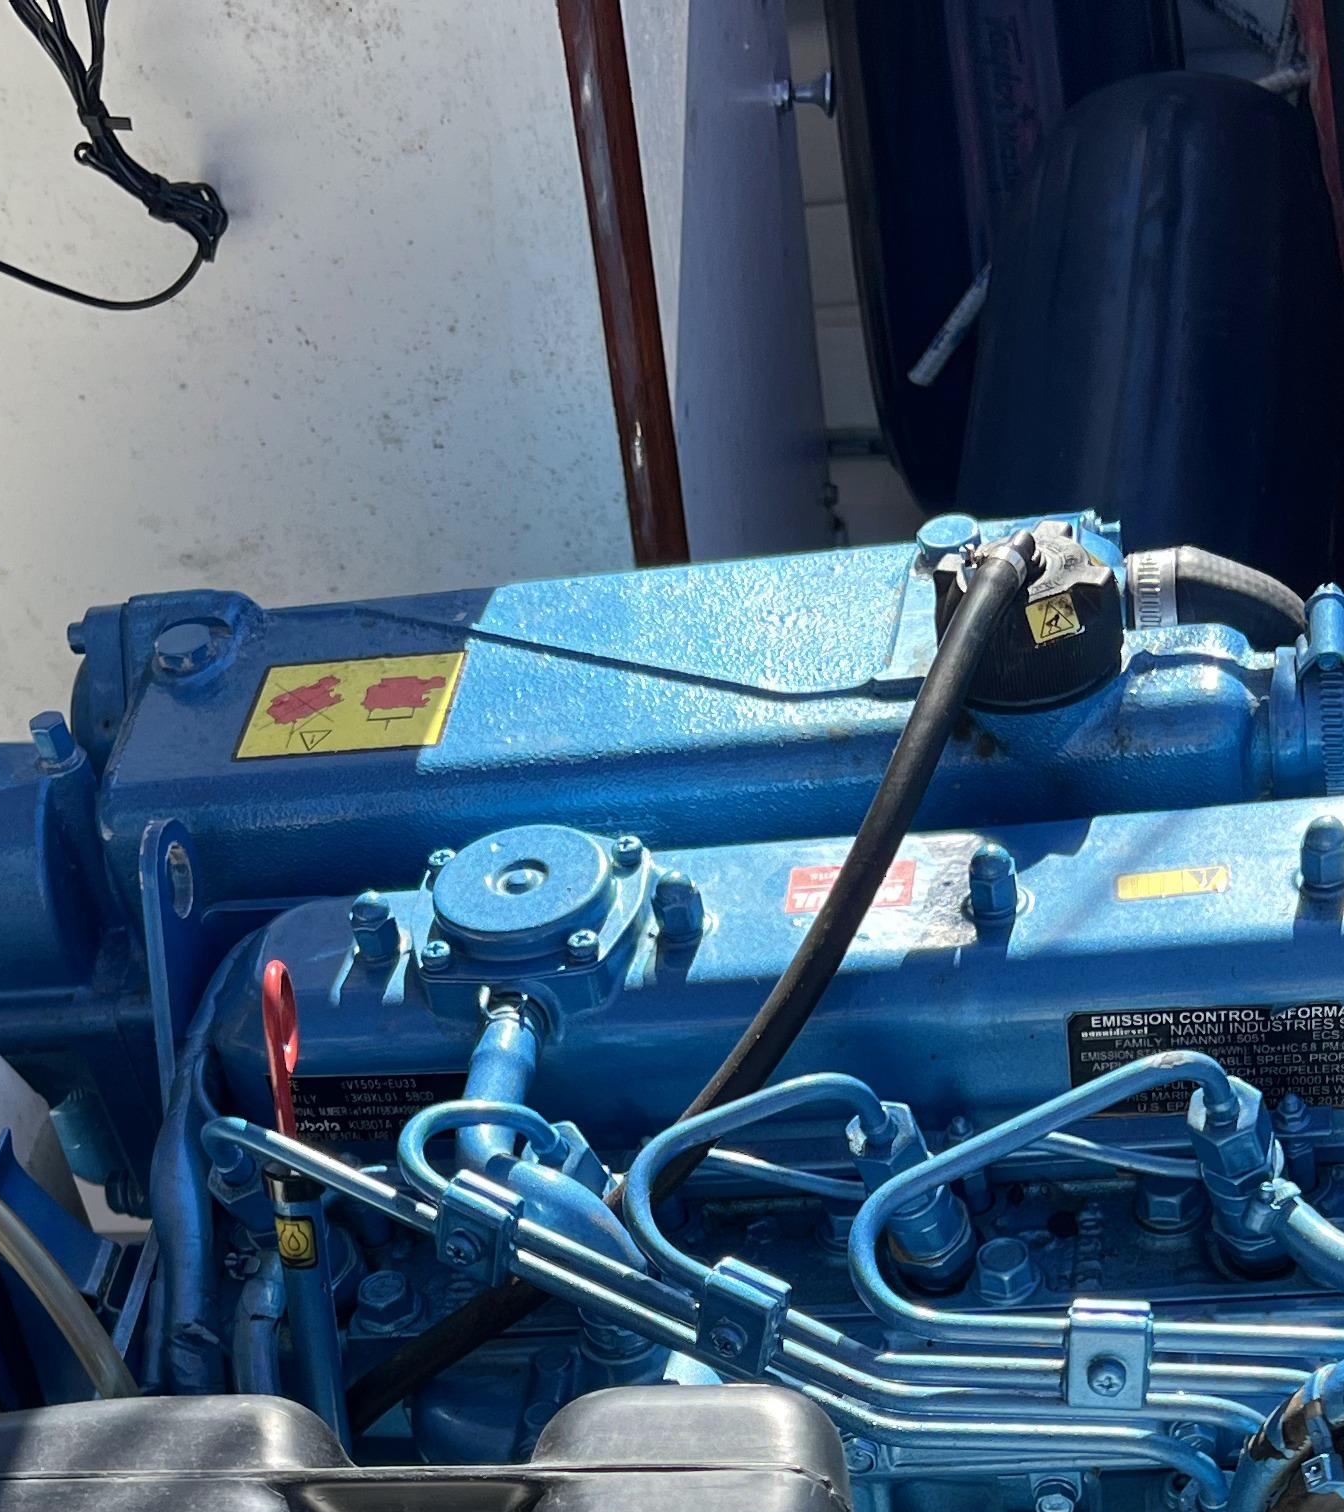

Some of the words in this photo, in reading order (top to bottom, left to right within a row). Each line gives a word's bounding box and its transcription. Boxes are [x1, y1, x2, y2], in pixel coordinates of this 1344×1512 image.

[1091, 1012, 1174, 1028] EMISSION
[1179, 1009, 1265, 1025] CONTROL
[1170, 1023, 1224, 1036] NANNI
[1229, 1018, 1334, 1034] INDUSTRIES
[1080, 1050, 1134, 1062] EMISSION
[296, 1119, 341, 1132] ubota
